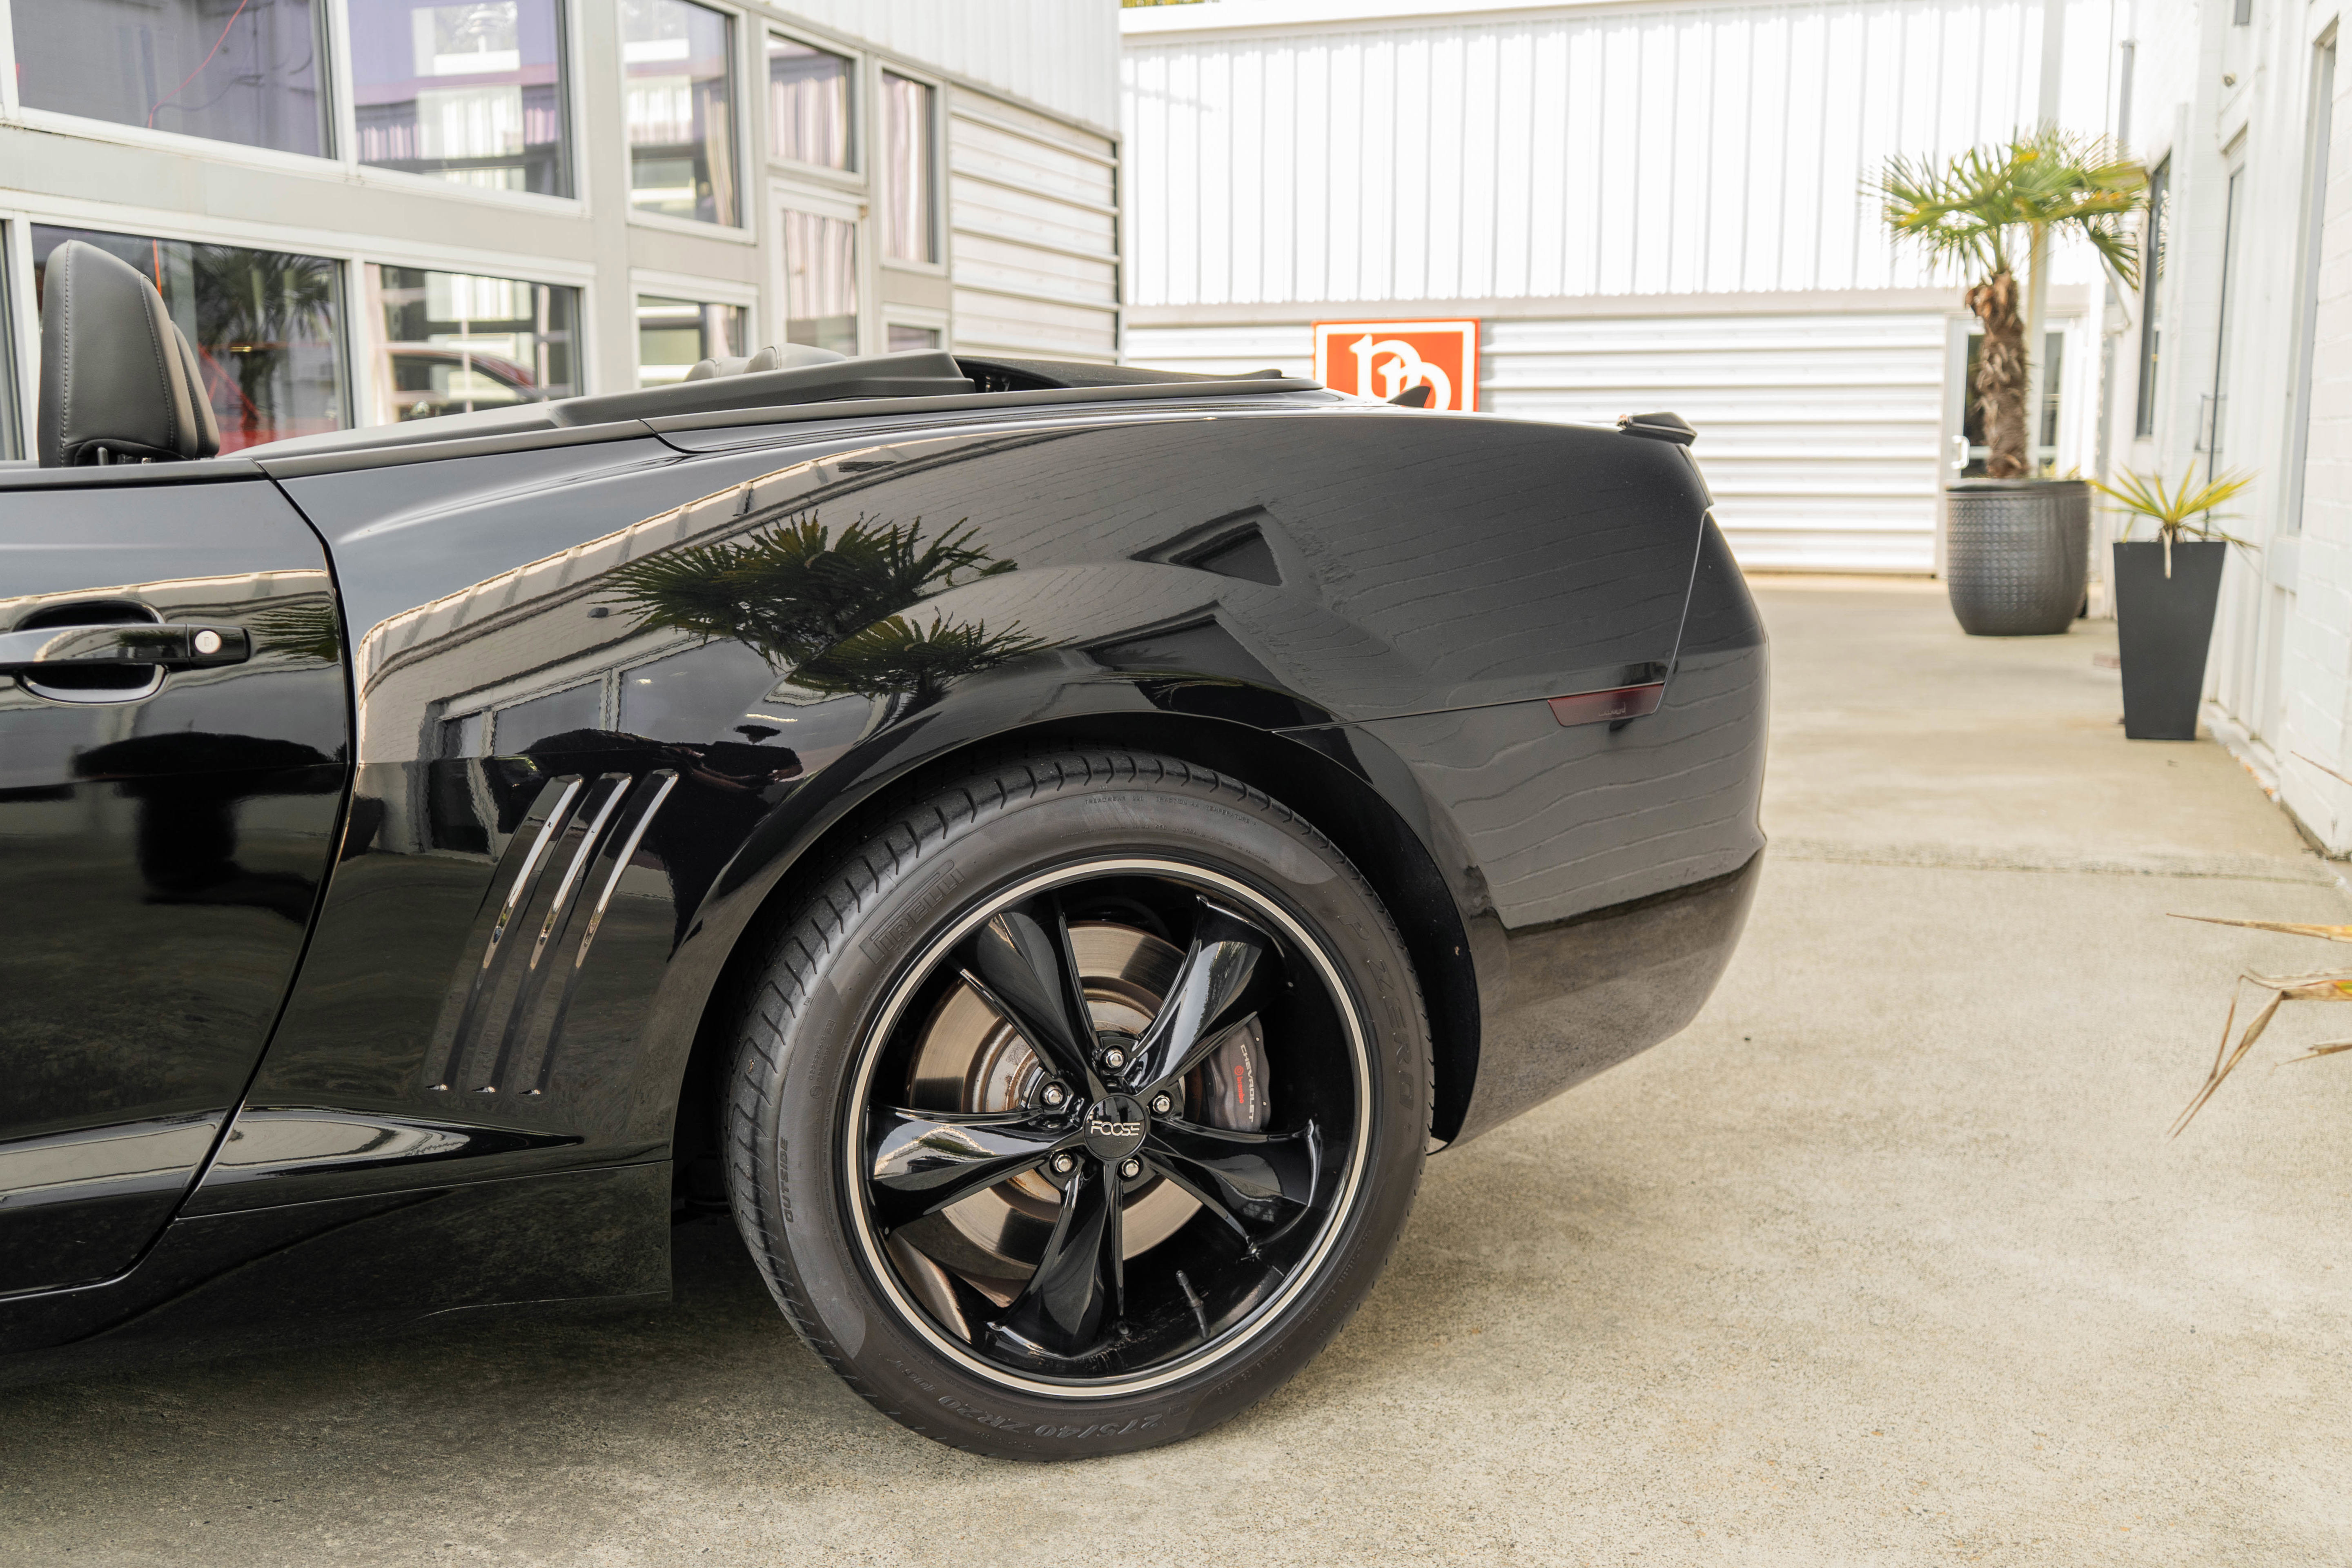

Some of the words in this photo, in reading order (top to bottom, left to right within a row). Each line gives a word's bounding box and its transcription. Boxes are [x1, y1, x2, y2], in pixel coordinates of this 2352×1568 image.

[858, 858, 966, 965] PIRELLI
[1366, 958, 1414, 1110] ZERO
[1240, 1044, 1255, 1123] CHEVROLET
[1090, 1120, 1141, 1136] FOOSE
[780, 1136, 794, 1222] OUTSIDE
[936, 1394, 1030, 1433] ZR20
[1033, 1412, 1161, 1438] 275/40
